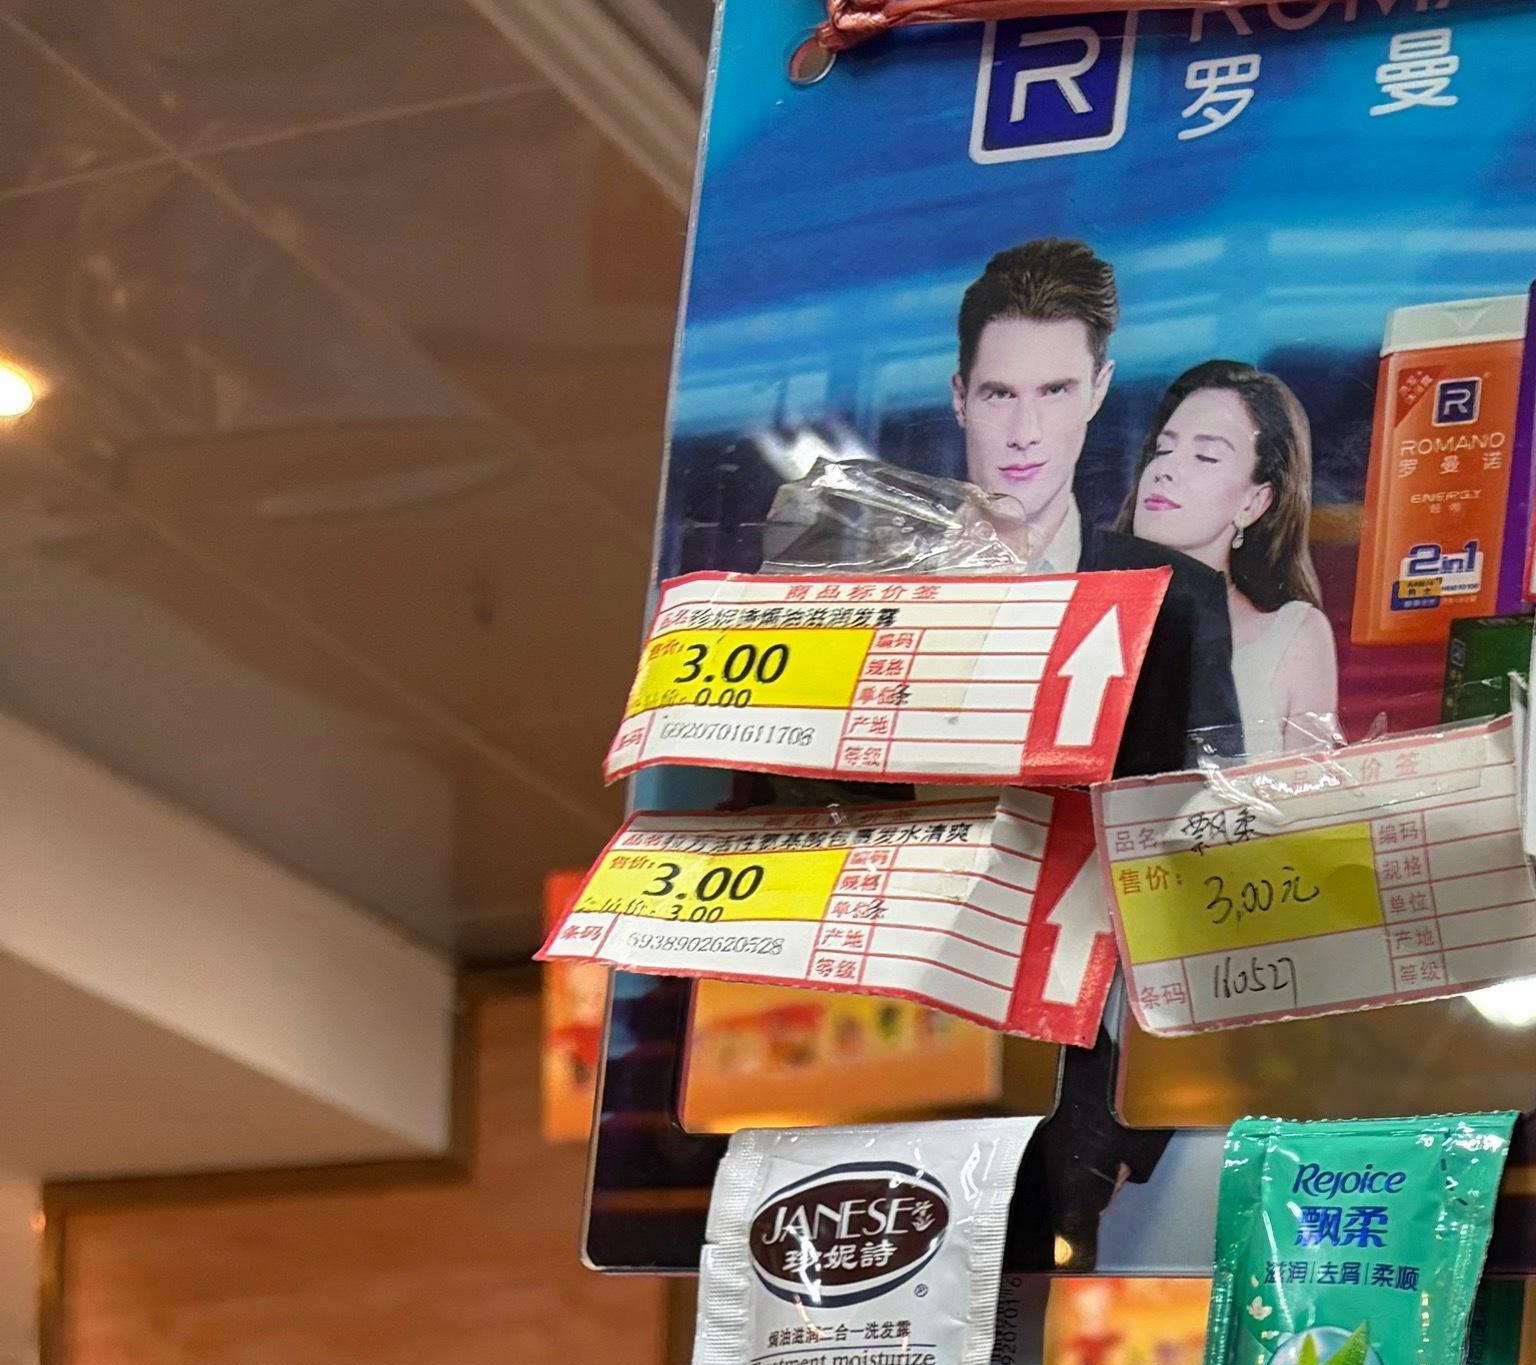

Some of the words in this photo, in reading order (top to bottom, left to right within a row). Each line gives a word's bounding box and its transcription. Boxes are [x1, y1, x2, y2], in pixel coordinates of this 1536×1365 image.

[1401, 432, 1505, 456] ROMANO
[1408, 540, 1479, 577] 2in1
[673, 643, 790, 685] 3.00
[693, 688, 753, 709] 0.00
[1378, 820, 1419, 844] 编码
[643, 862, 765, 902] 3.00
[1382, 856, 1423, 881] 规格
[670, 904, 724, 923] 3.00
[1388, 890, 1430, 914] 单位
[1140, 979, 1188, 1011] 条码
[1291, 1162, 1407, 1201] Rejoice
[762, 1196, 913, 1245] JANESE
[1293, 1205, 1389, 1249] 飘柔
